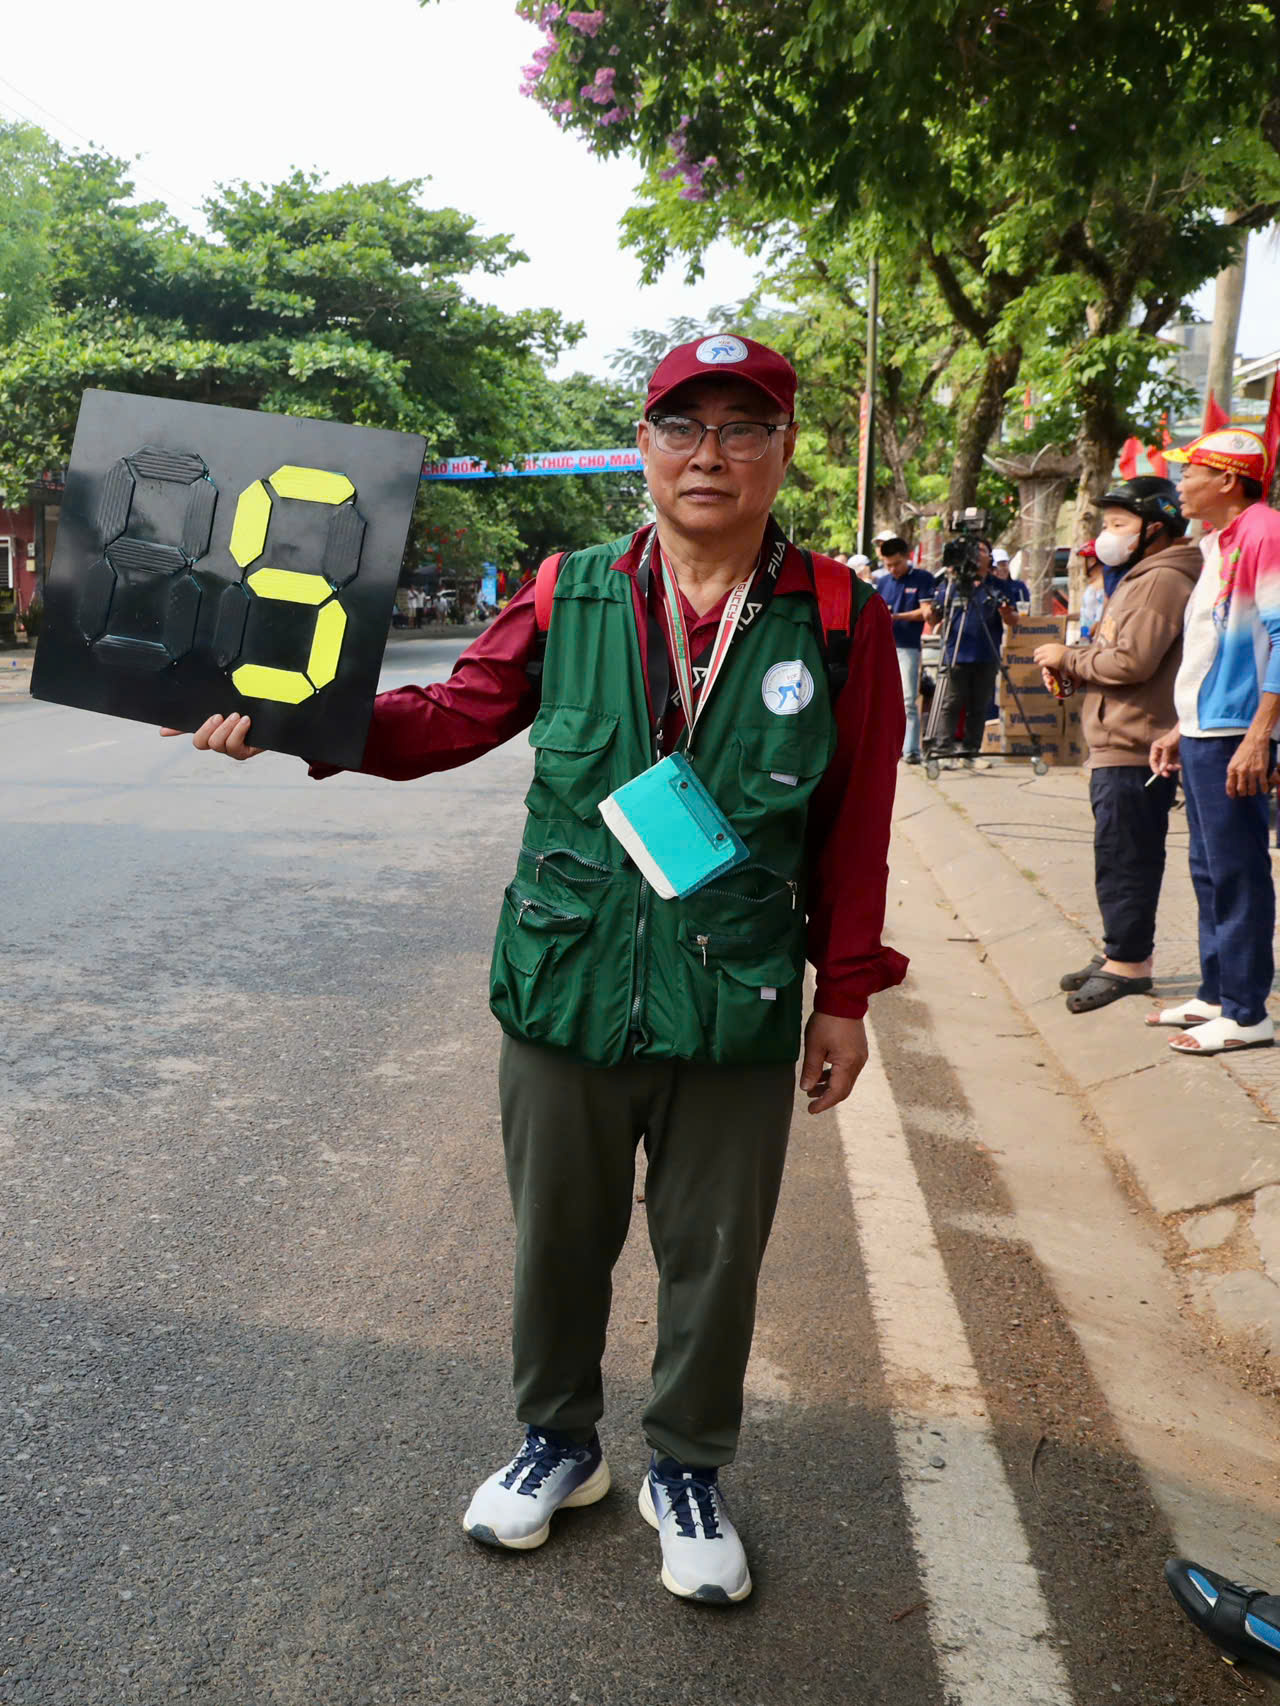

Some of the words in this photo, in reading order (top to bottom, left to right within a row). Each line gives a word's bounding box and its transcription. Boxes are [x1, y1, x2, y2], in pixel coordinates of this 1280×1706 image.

[579, 455, 605, 468] CHO
[610, 453, 637, 465] MAI
[767, 541, 786, 580] FILA
[736, 602, 763, 632] ILA
[1007, 655, 1035, 665] Vina
